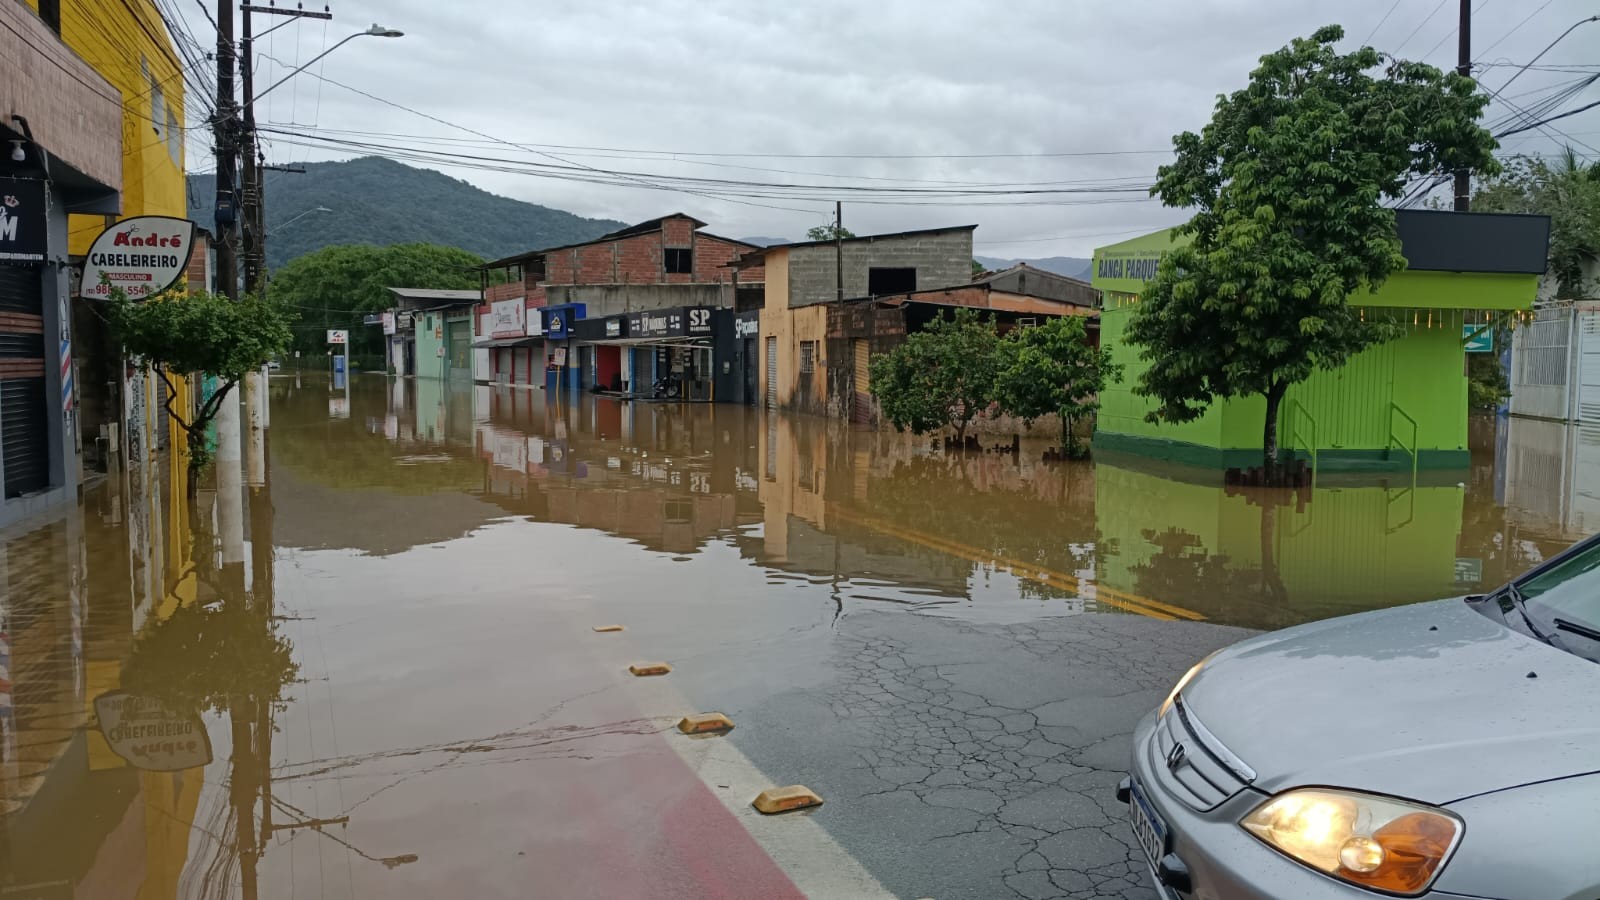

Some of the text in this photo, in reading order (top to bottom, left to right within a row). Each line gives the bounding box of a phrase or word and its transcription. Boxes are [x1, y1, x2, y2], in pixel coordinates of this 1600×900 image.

[113, 232, 182, 247] André
[91, 253, 178, 268] CABELEIREIRO
[1098, 259, 1123, 279] BANCA
[108, 273, 147, 281] MASCULINO
[689, 309, 711, 326] SP
